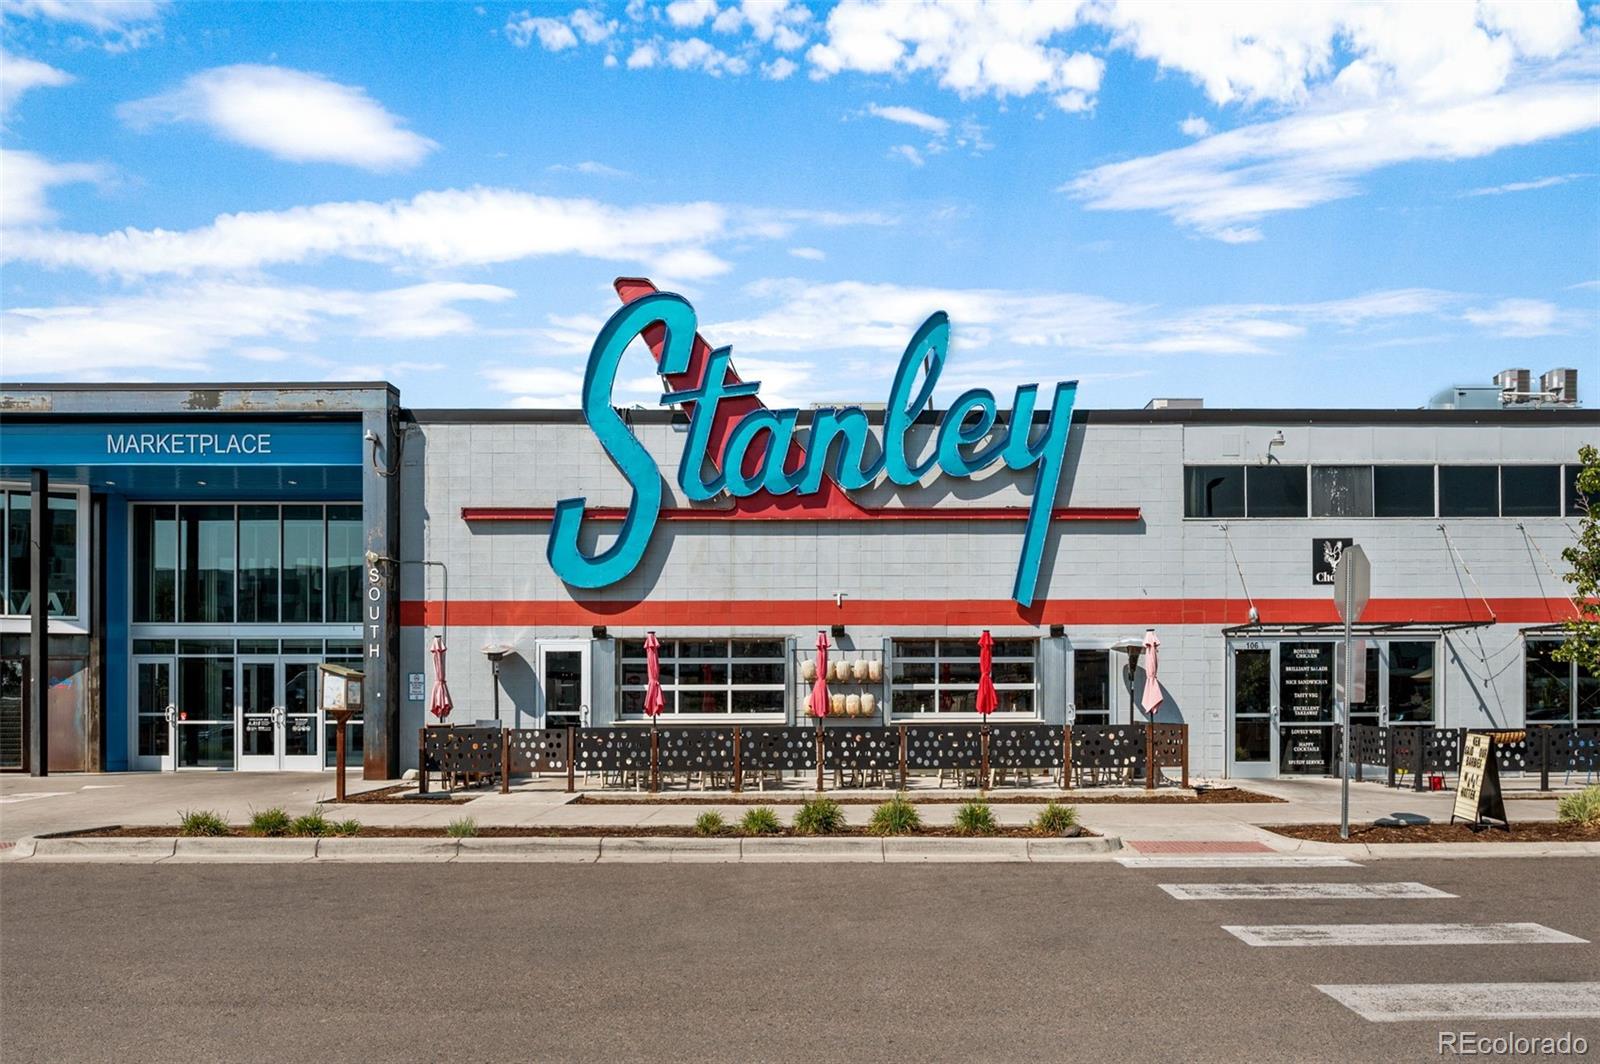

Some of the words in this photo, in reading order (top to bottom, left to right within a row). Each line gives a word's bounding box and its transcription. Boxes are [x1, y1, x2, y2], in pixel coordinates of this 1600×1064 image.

[107, 434, 271, 454] MARKETPLACE
[546, 291, 1078, 608] Stanley
[368, 567, 381, 658] SOUTH
[1246, 641, 1259, 649] 106
